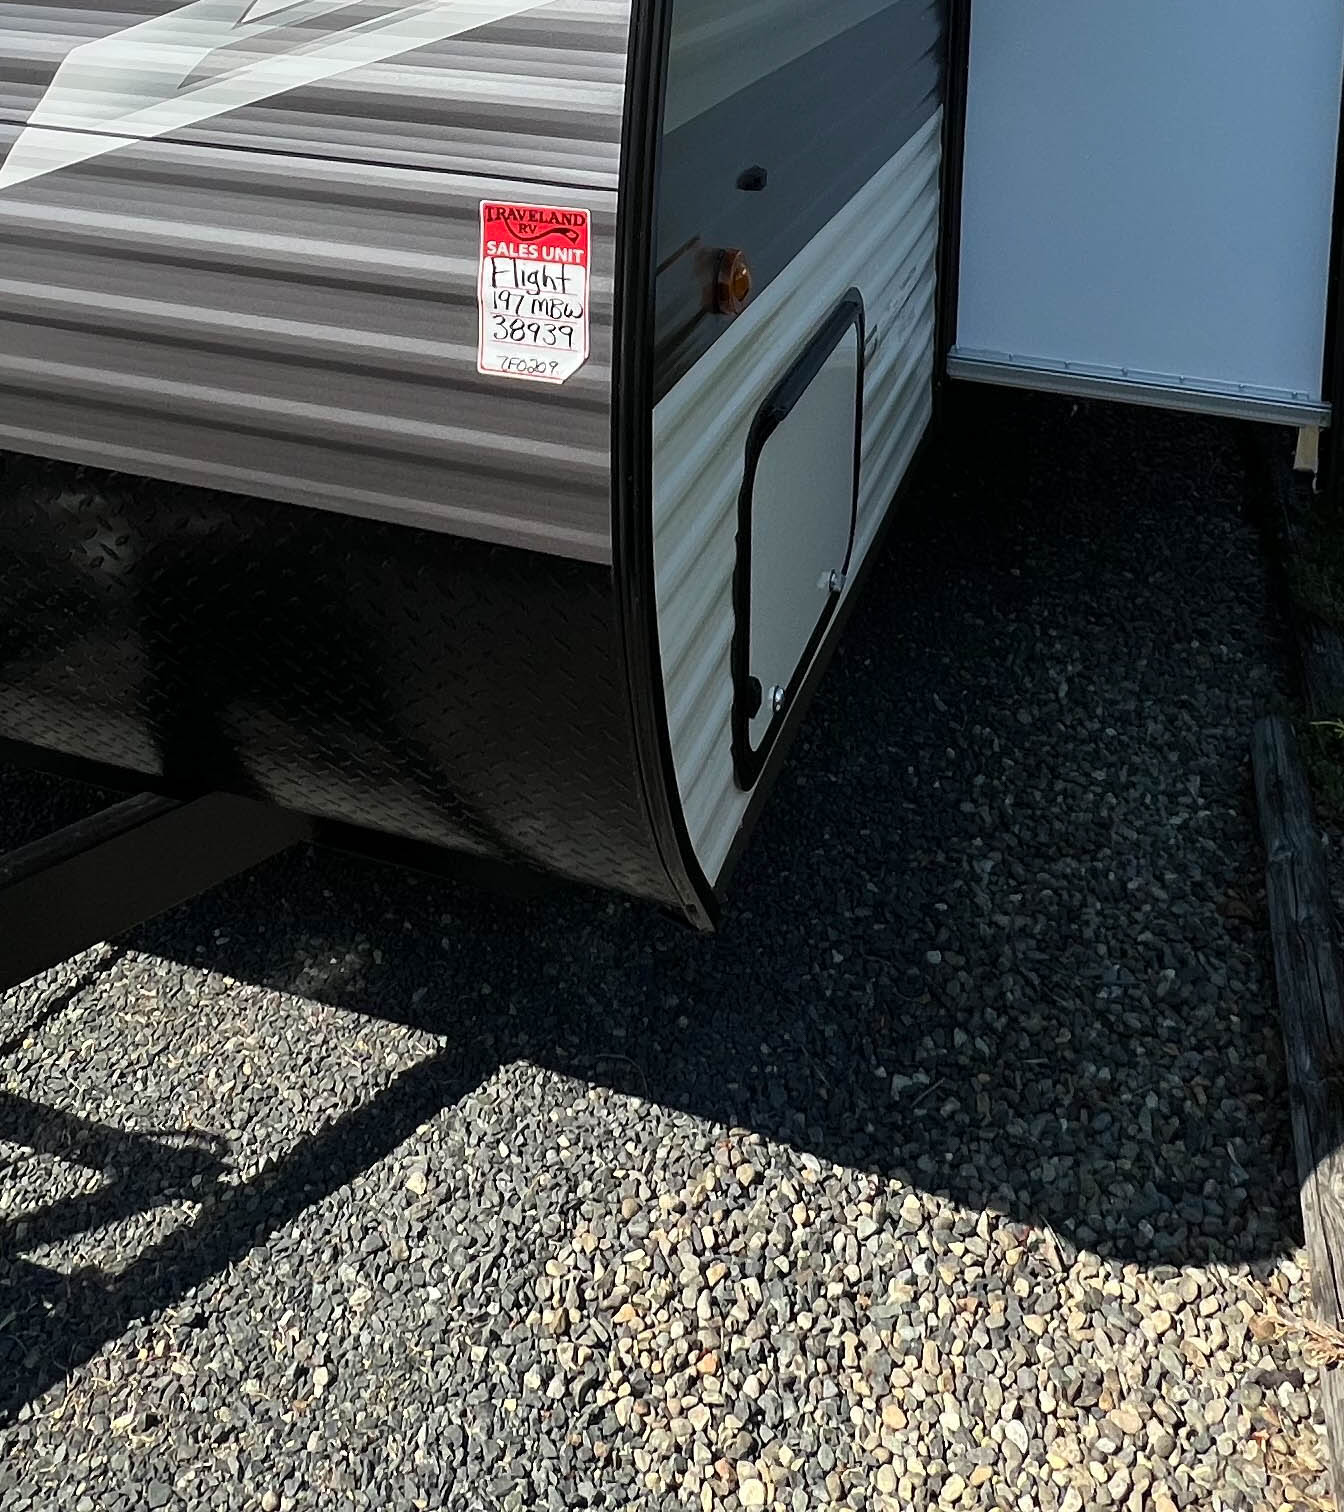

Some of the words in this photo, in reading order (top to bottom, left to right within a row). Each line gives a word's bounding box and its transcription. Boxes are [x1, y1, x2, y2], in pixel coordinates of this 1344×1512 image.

[484, 205, 586, 227] TRAVELAND
[518, 223, 537, 234] RV
[487, 240, 538, 259] SALES
[542, 245, 584, 263] UNIT
[492, 314, 574, 348] 38939
